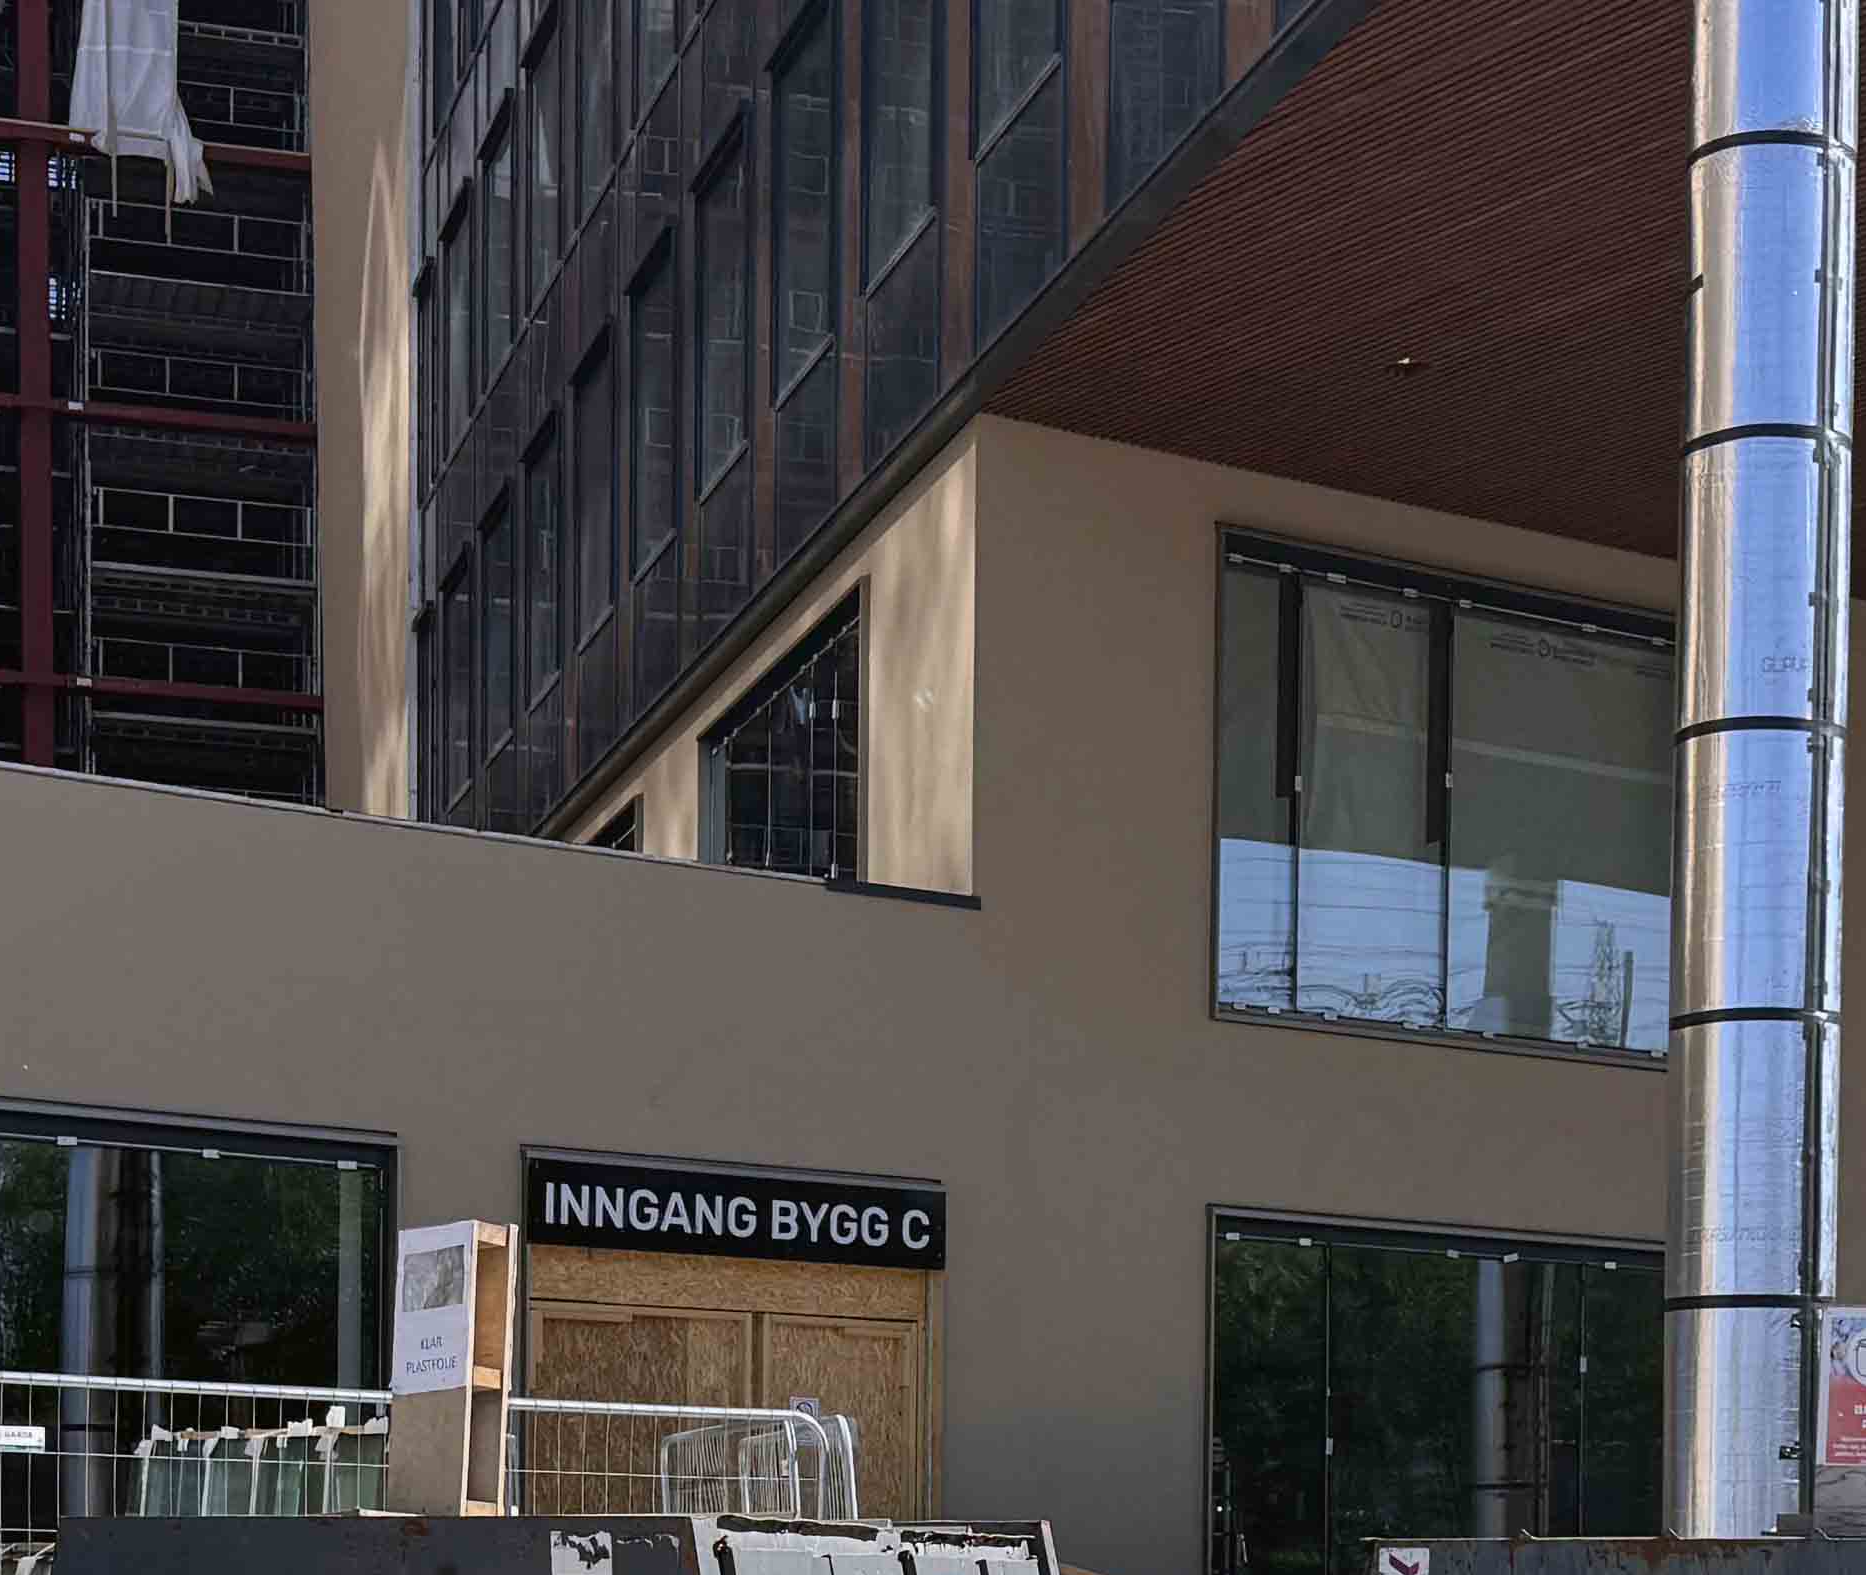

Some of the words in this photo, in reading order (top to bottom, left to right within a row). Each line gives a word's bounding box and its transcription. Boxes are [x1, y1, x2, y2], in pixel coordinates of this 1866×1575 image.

[544, 1181, 758, 1239] INNGANG
[770, 1199, 890, 1246] BYGG
[901, 1209, 931, 1249] C
